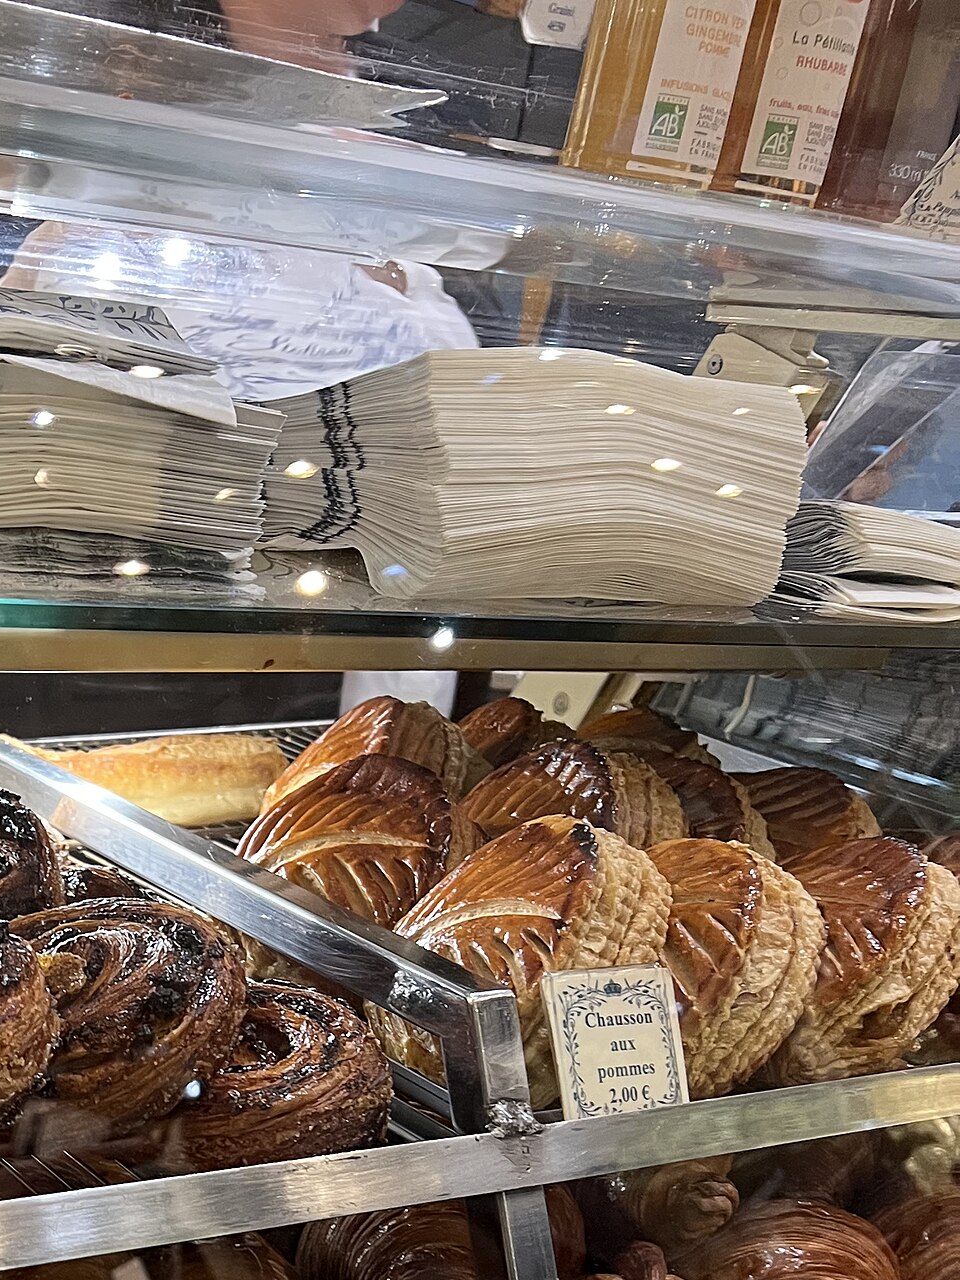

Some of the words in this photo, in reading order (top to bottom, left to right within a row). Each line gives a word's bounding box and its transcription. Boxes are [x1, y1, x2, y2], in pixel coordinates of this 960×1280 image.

[685, 5, 729, 24] CITRON
[792, 31, 809, 45] La
[698, 40, 731, 58] POMME
[796, 55, 848, 76] RHUBARBE
[661, 78, 708, 94] INFUSIONS
[650, 112, 680, 137] AB
[761, 131, 789, 155] AB
[584, 1011, 653, 1028] Chausson
[610, 1039, 637, 1052] aux
[597, 1062, 656, 1083] pommes
[609, 1085, 638, 1105] 2,00
[641, 1084, 651, 1101] €
